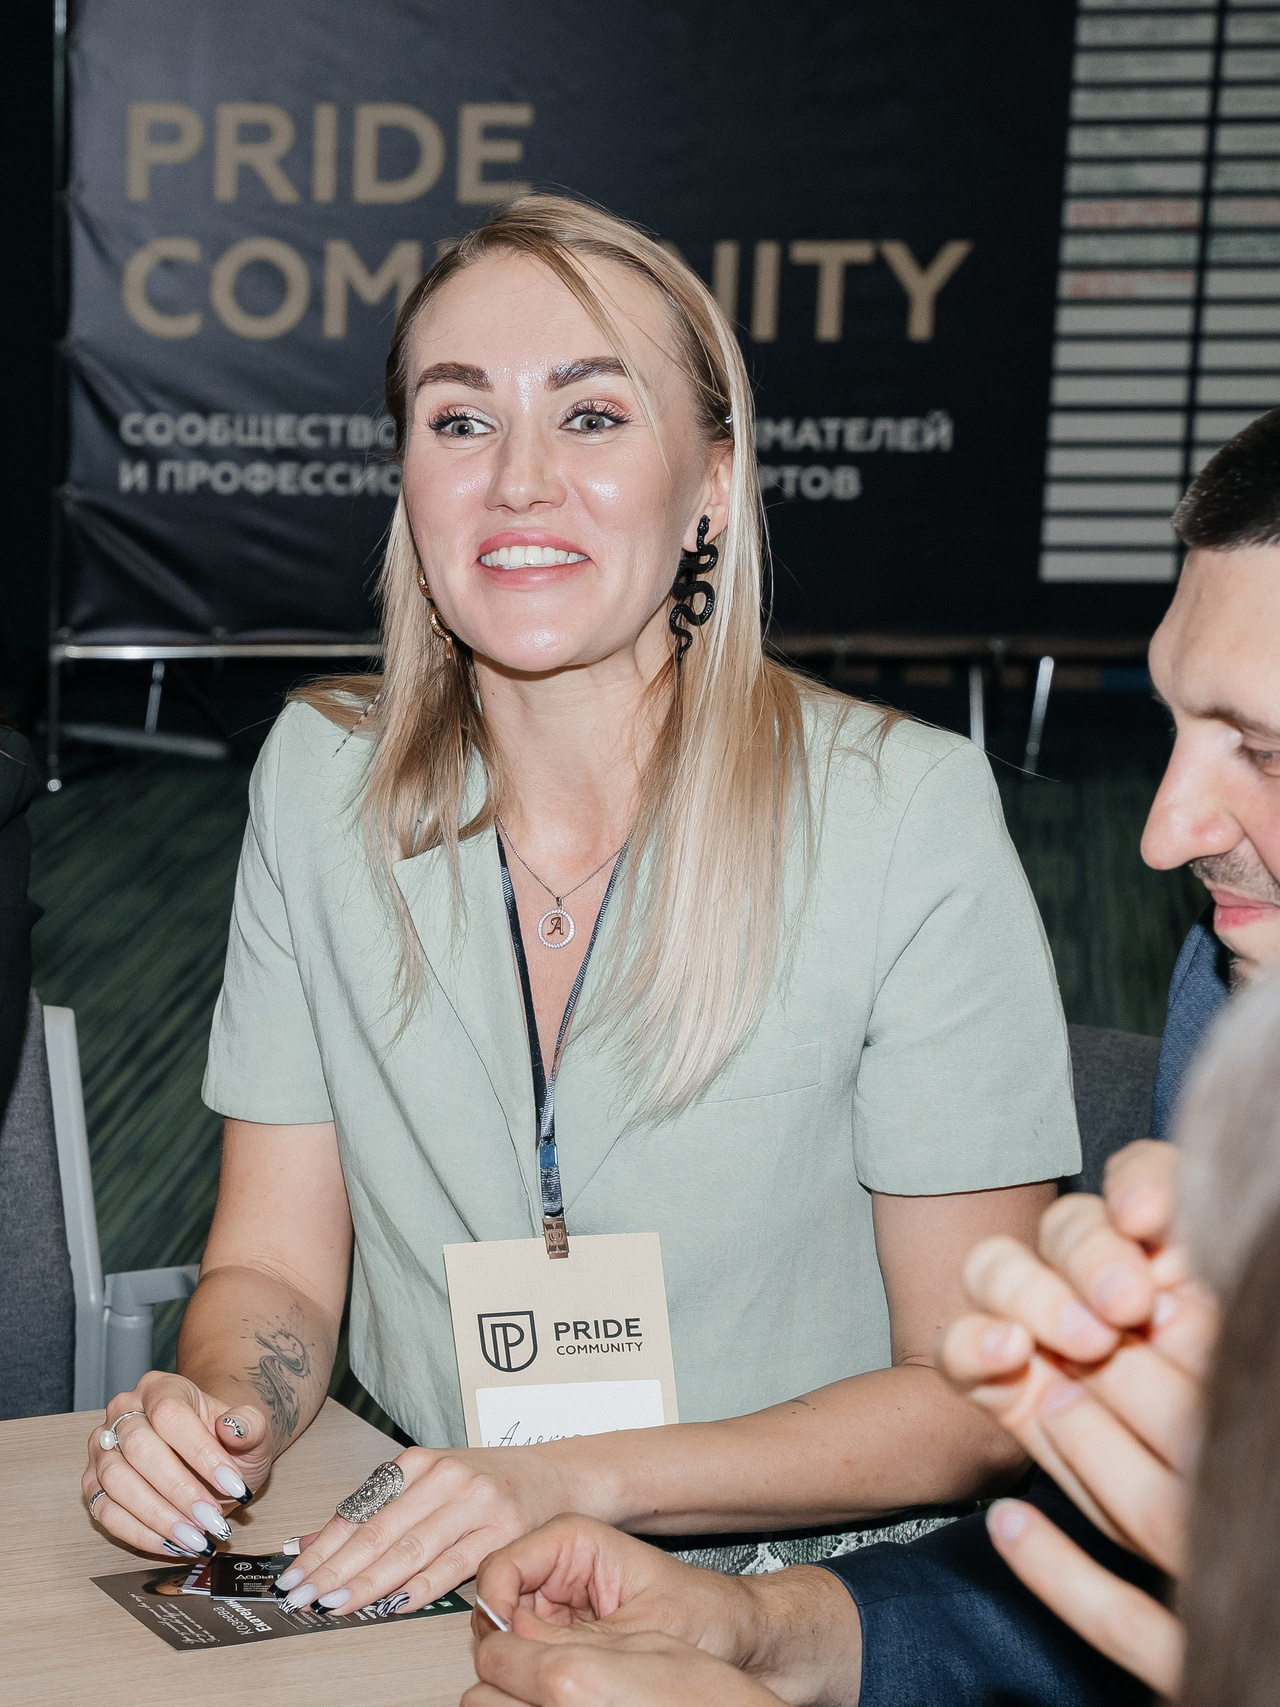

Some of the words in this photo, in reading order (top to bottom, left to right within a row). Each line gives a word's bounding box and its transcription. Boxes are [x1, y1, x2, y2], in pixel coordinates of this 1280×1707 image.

[125, 101, 535, 205] PRIDE
[118, 459, 150, 493] И
[156, 460, 404, 498] ПРОФЕССИО
[553, 1318, 643, 1342] PRIDE
[556, 1341, 643, 1356] COMMUNITY
